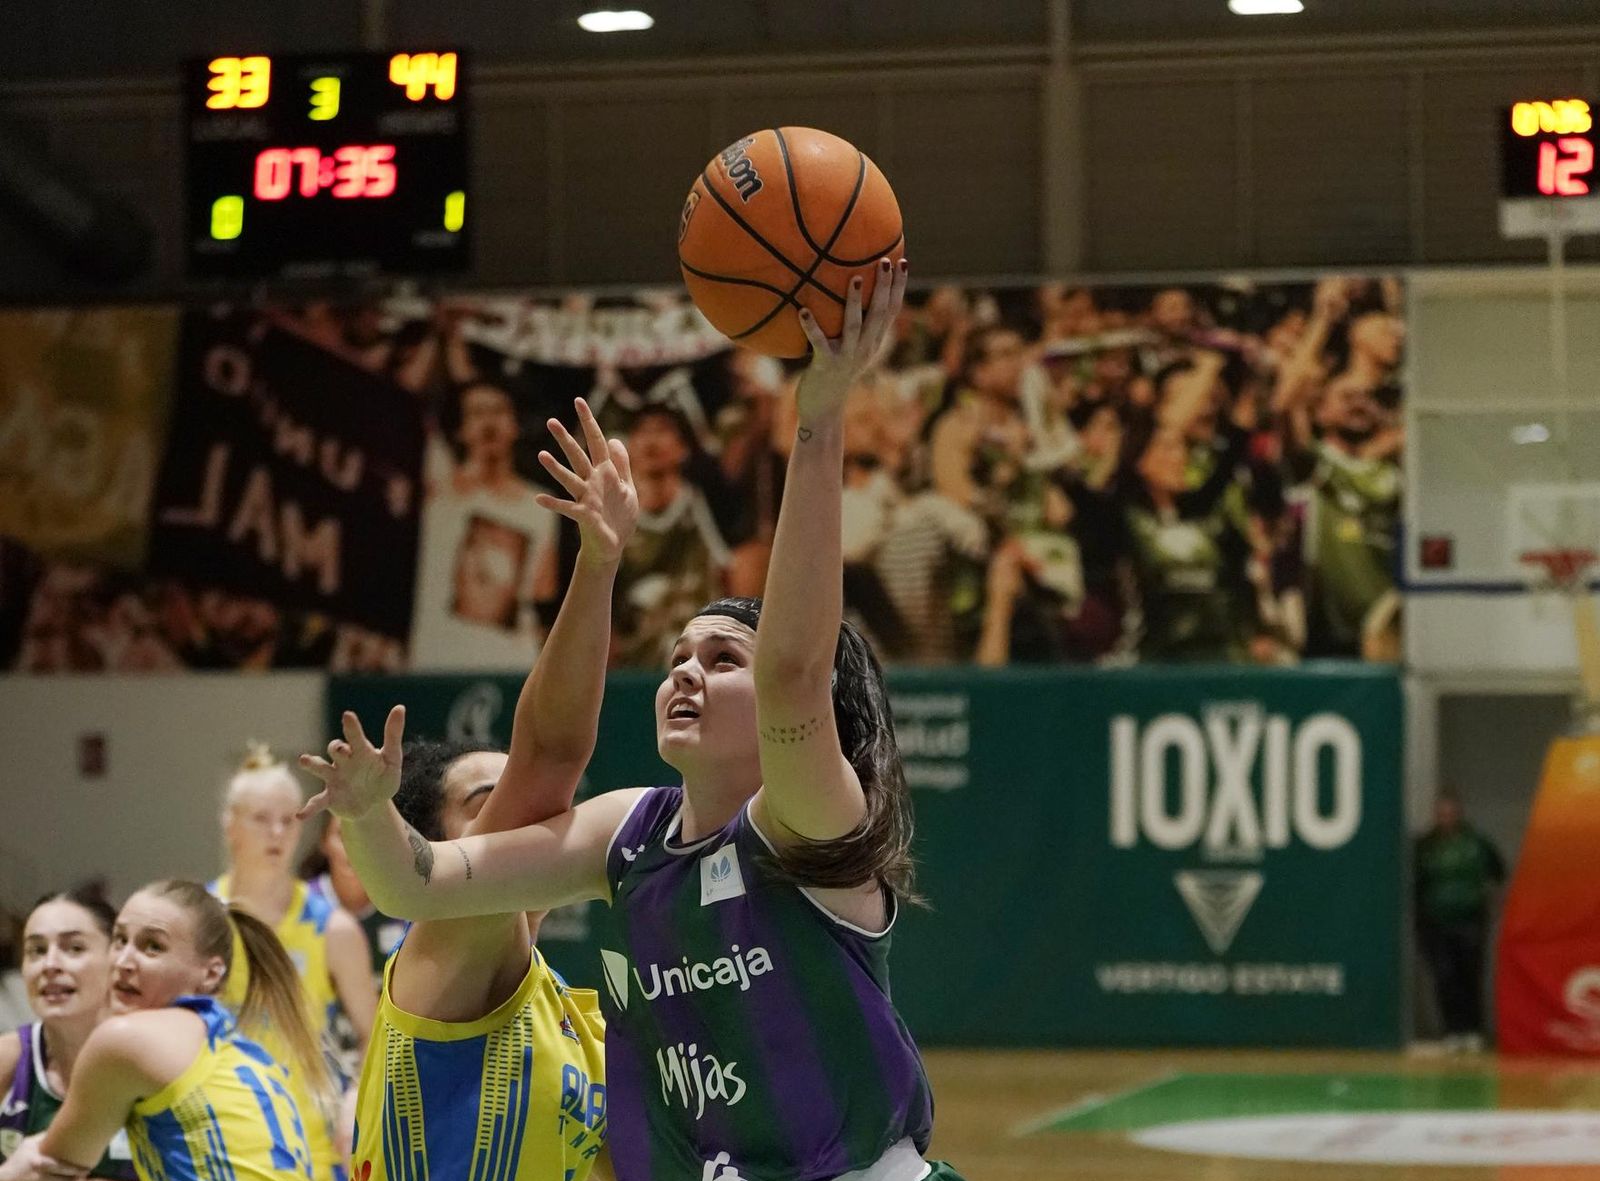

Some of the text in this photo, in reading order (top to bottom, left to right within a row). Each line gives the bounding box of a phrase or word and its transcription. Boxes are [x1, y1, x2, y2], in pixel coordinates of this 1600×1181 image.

[206, 53, 457, 109] 33 44
[308, 77, 340, 121] 3
[254, 145, 396, 200] 07:35
[1538, 138, 1594, 195] 12
[444, 190, 465, 232] 1
[633, 944, 774, 1001] Unicaja
[656, 1042, 747, 1120] Mijas
